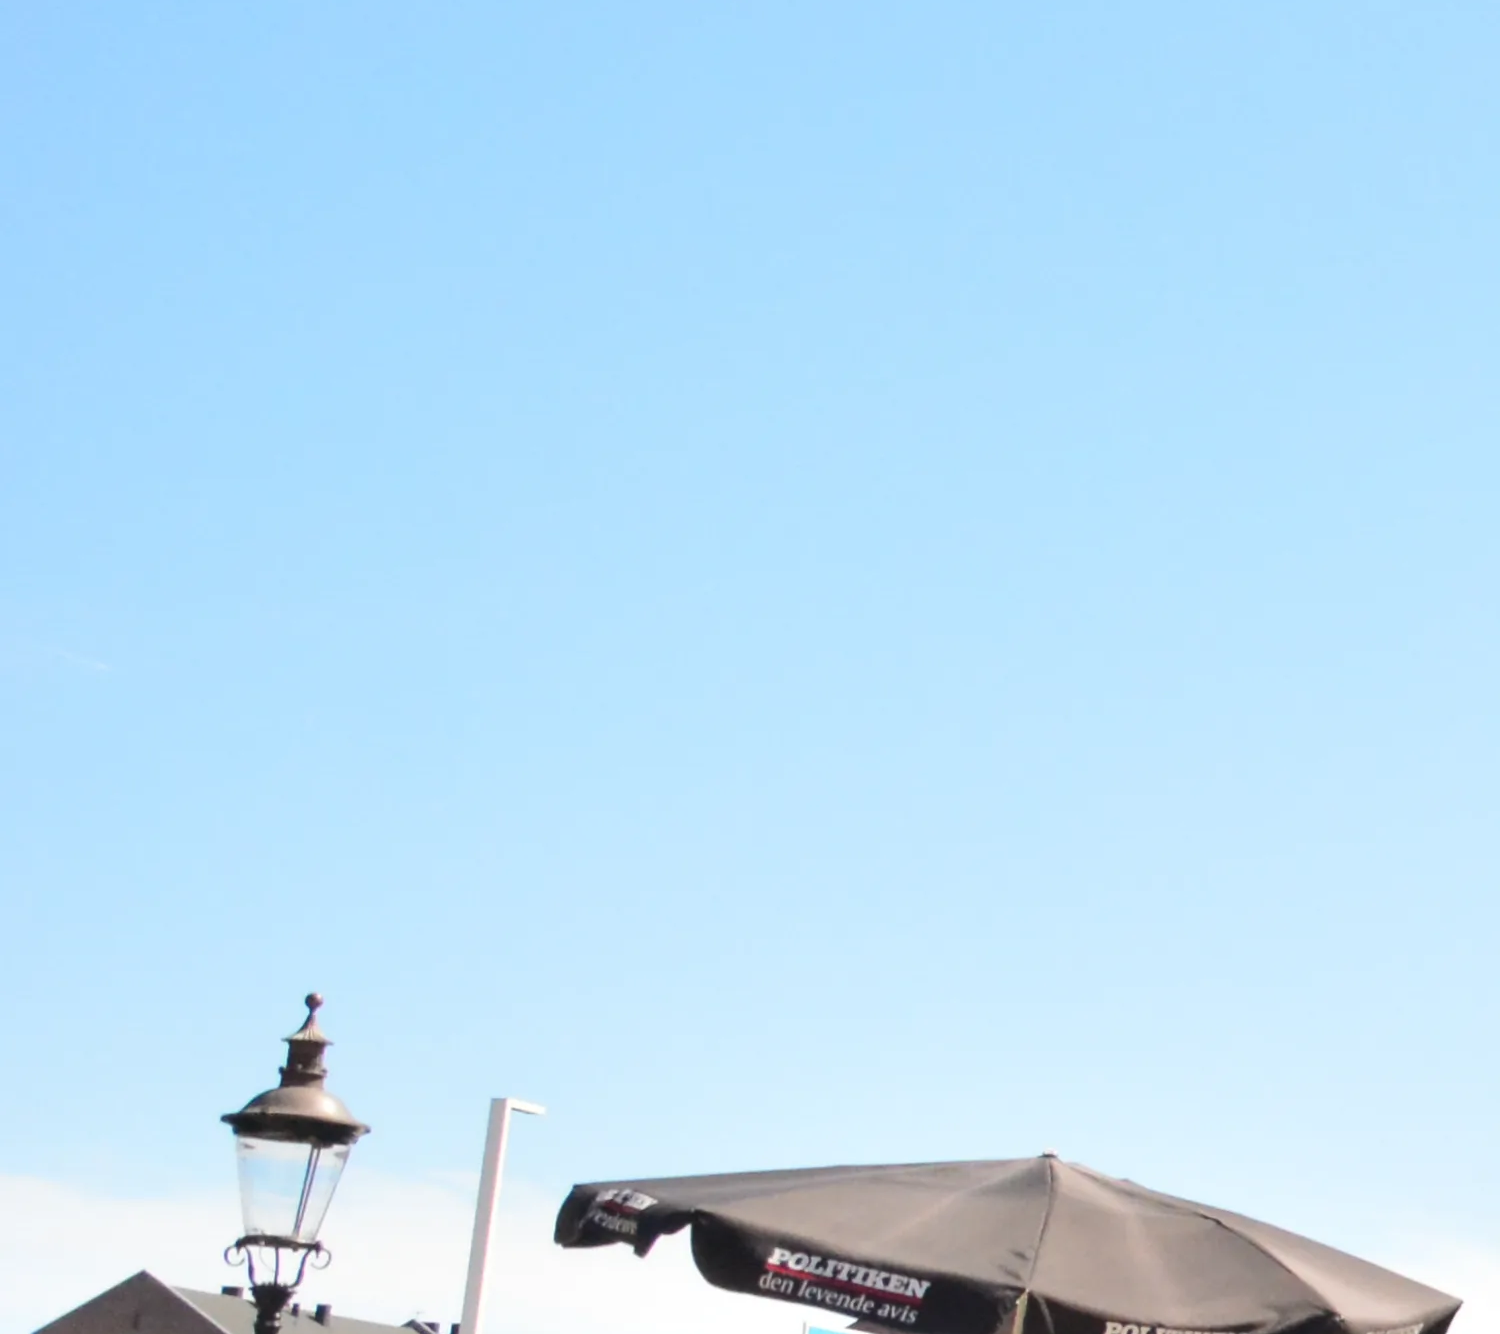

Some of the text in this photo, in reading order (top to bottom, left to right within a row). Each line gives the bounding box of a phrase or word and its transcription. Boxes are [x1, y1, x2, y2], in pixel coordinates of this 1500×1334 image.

[758, 1271, 919, 1324] den levende avis
[768, 1247, 931, 1299] POLITIKEN
